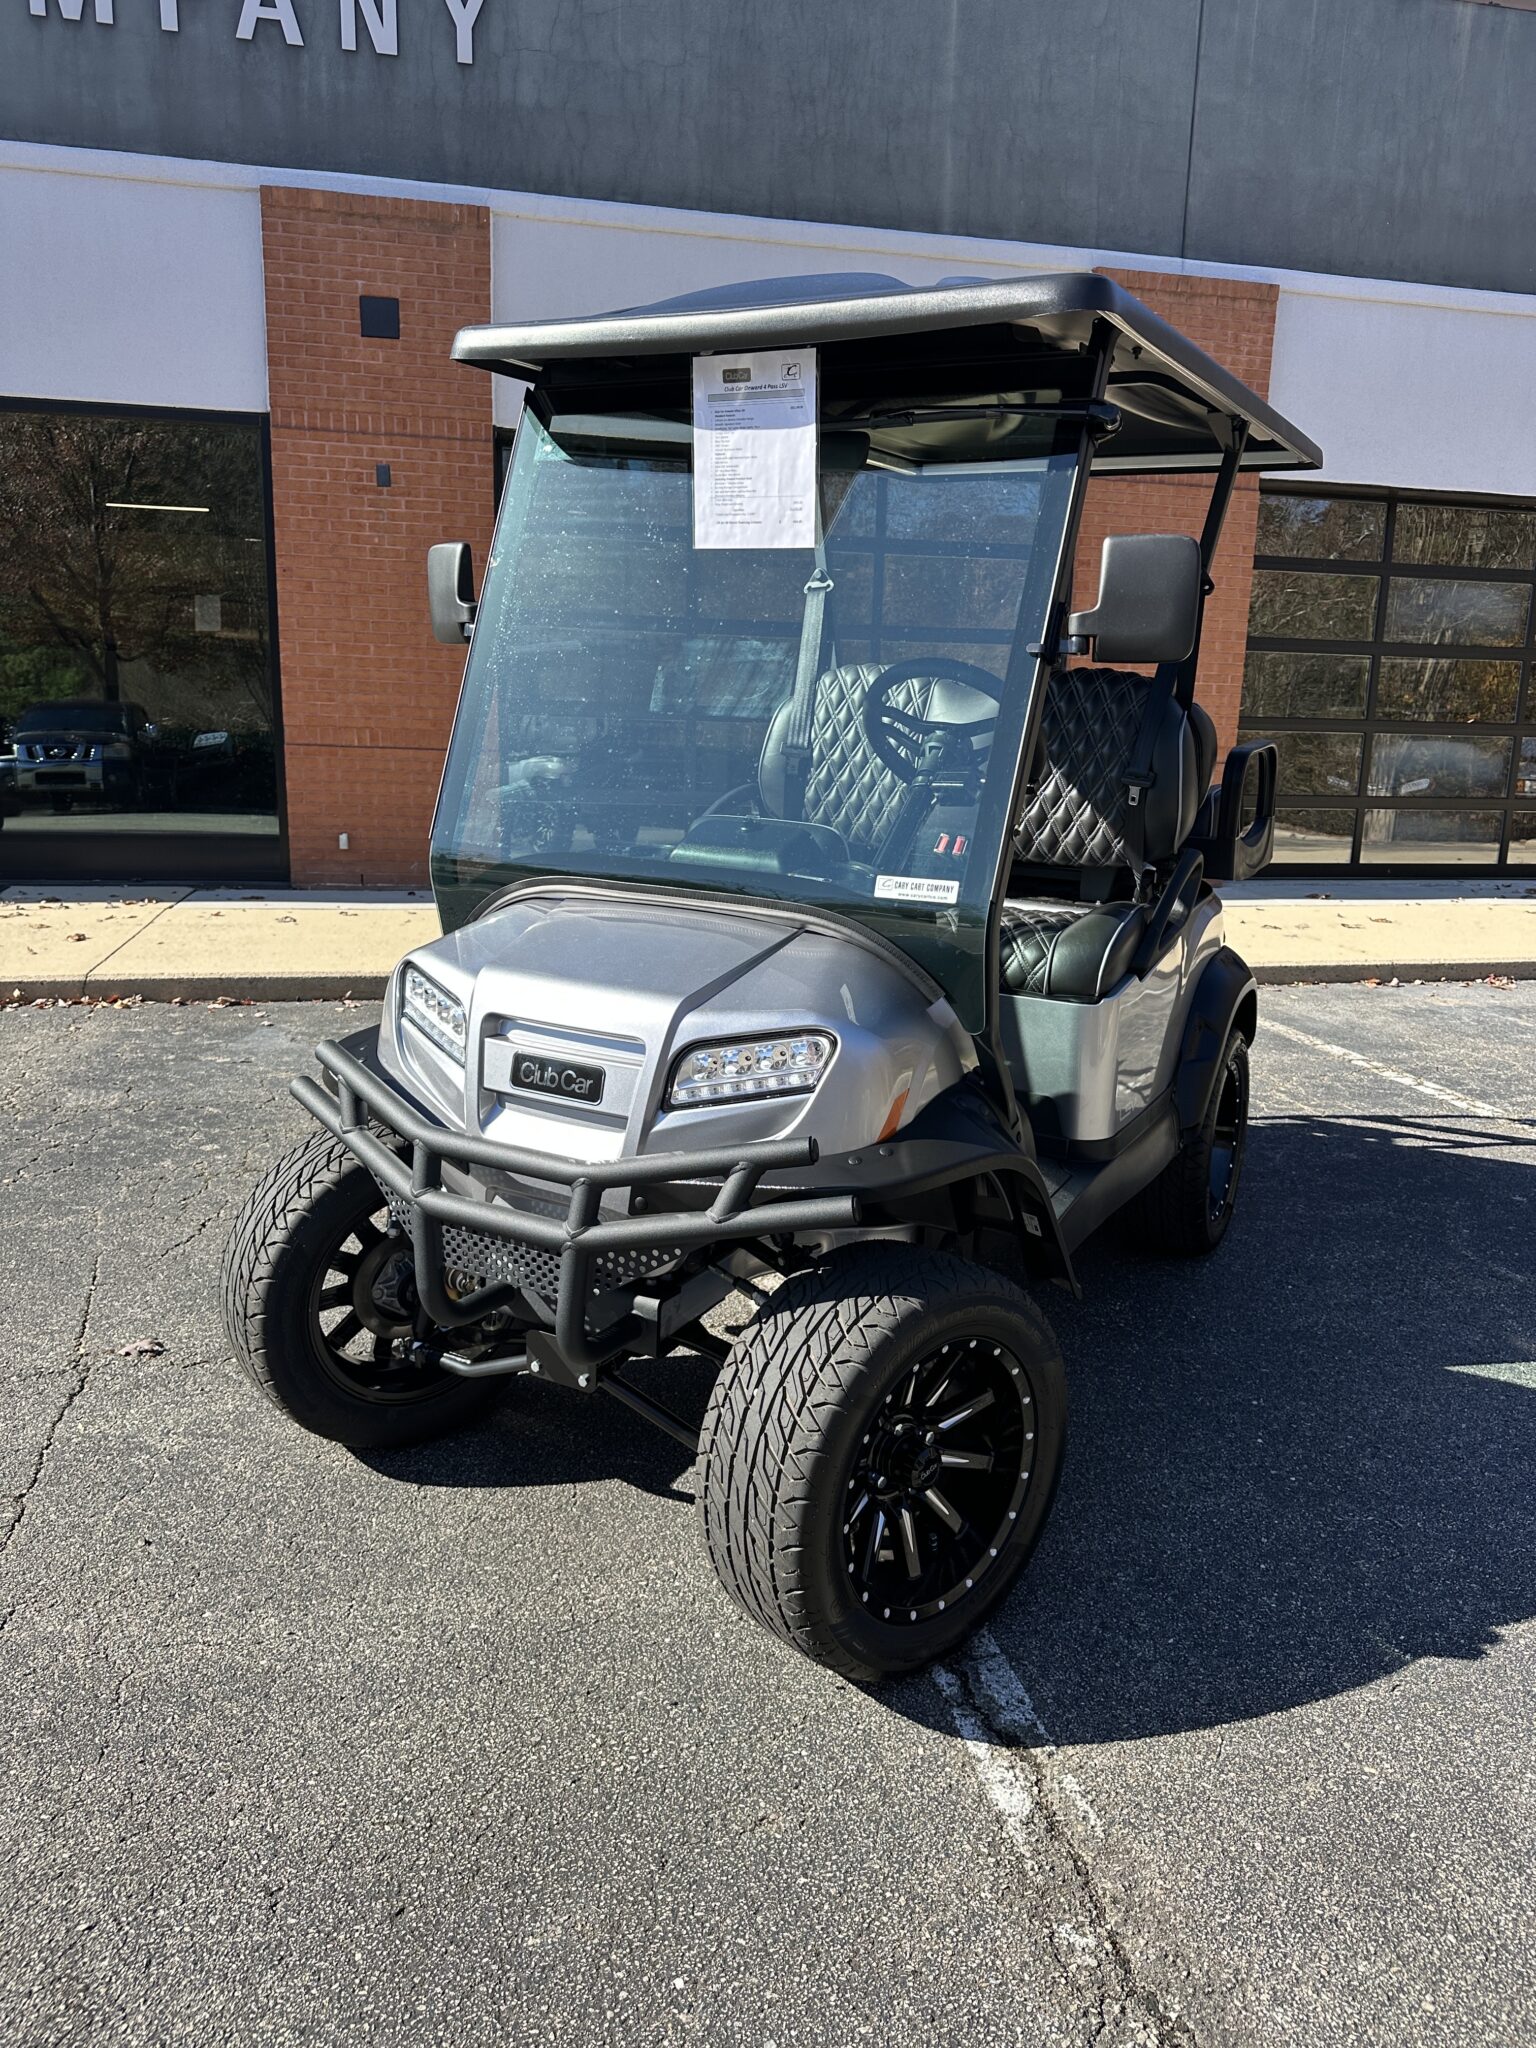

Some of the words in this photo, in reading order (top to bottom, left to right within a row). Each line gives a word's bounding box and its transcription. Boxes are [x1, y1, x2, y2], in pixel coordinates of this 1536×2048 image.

[894, 881, 909, 890] CARY
[910, 882, 926, 892] CART
[926, 884, 954, 894] COMPANY
[520, 1061, 559, 1088] Club
[560, 1069, 594, 1095] Car
